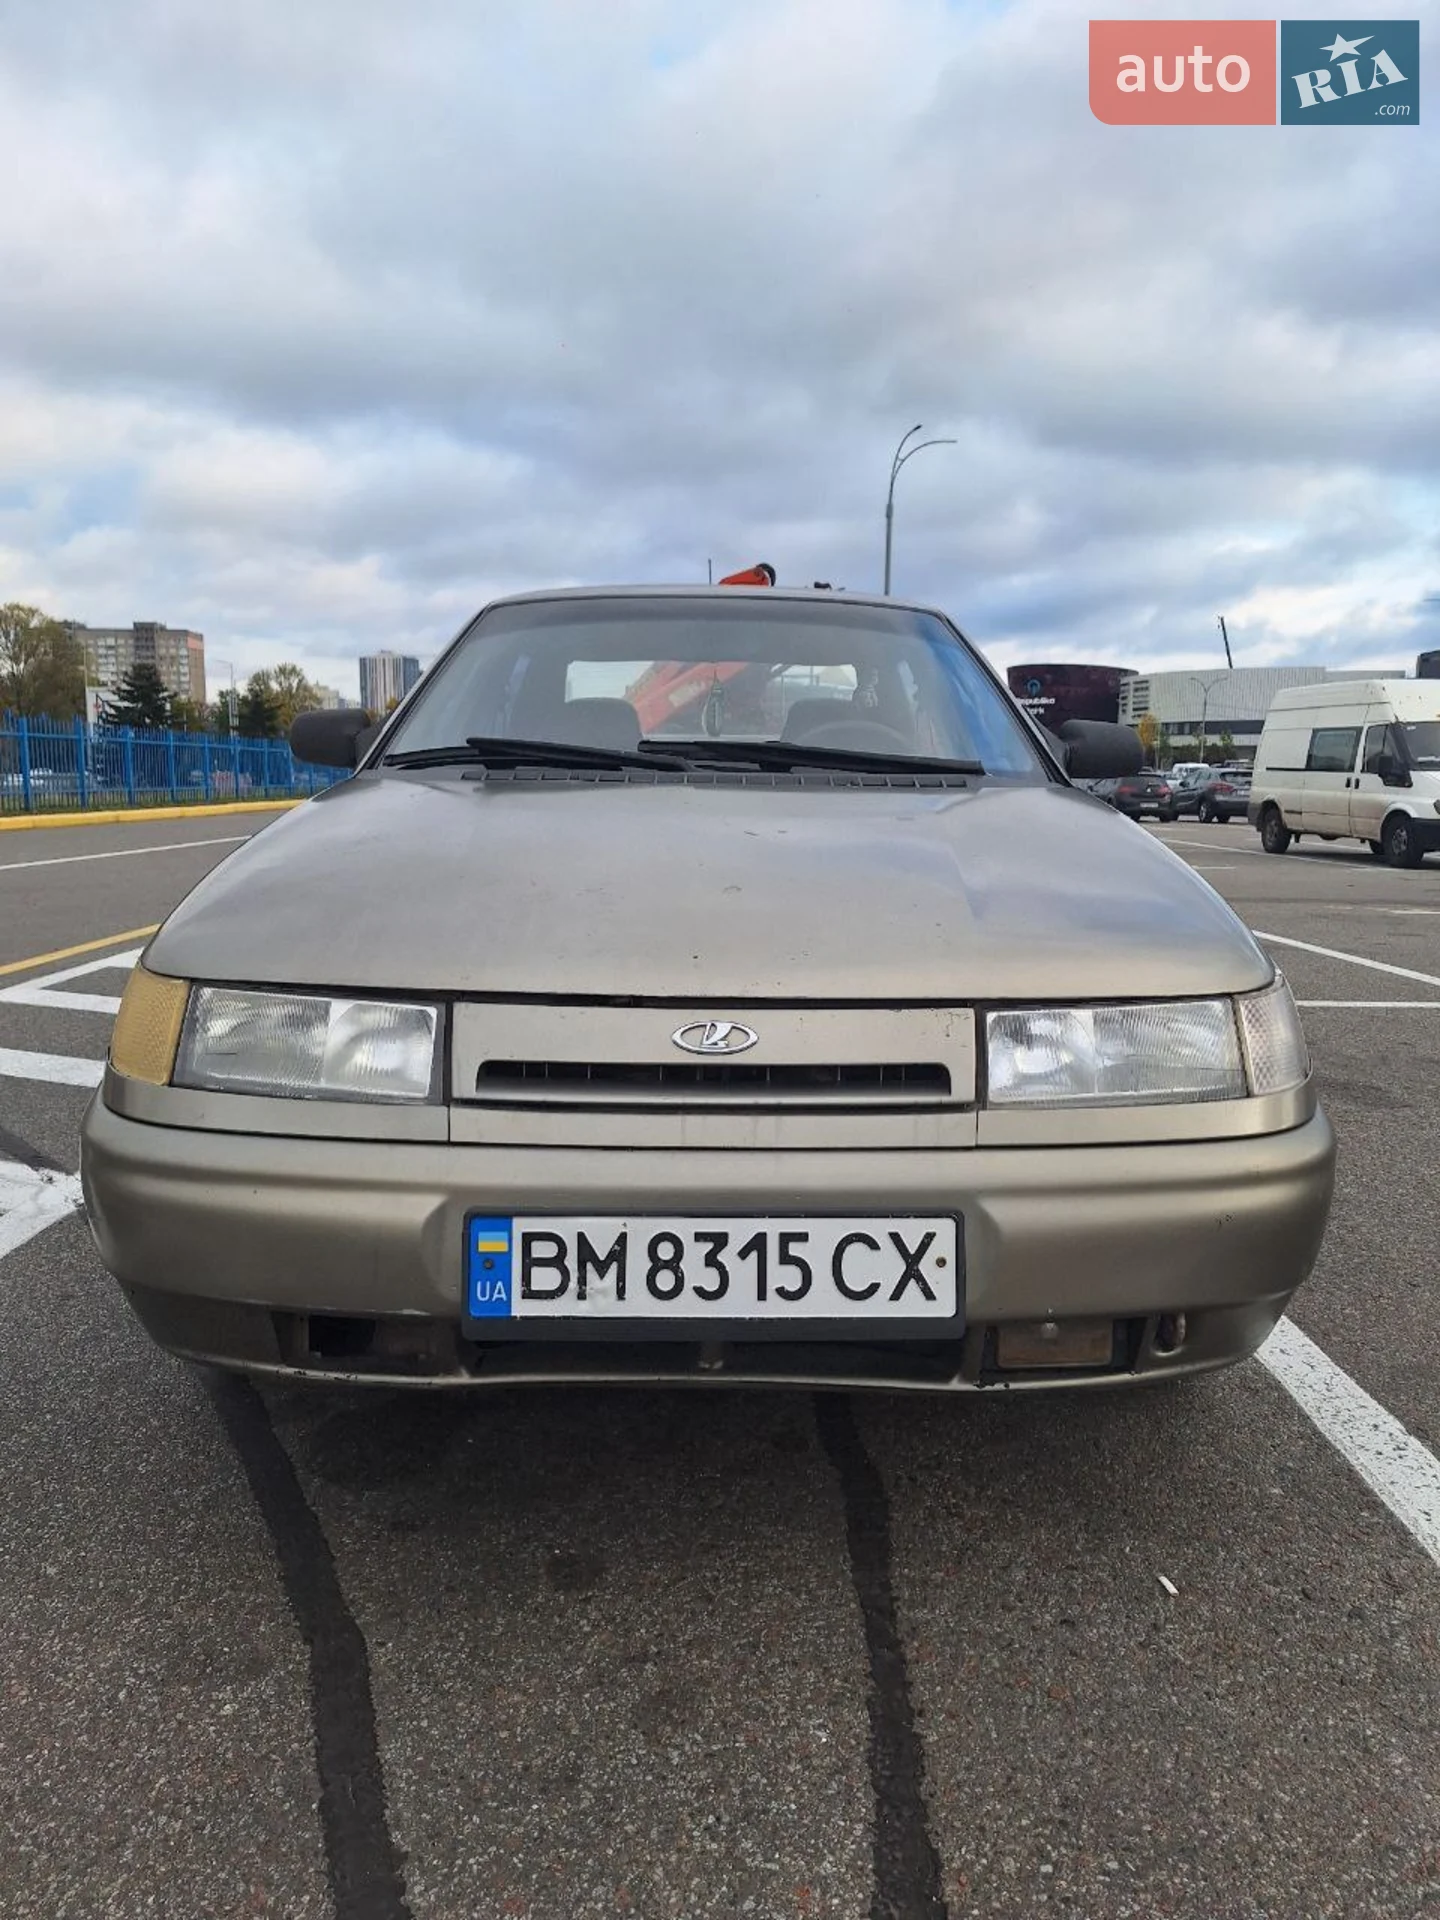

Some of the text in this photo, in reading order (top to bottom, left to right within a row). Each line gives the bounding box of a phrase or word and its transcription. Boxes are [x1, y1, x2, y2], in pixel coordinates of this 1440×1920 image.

[521, 1231, 937, 1301] BM 8315 CX
[476, 1280, 507, 1301] UA
